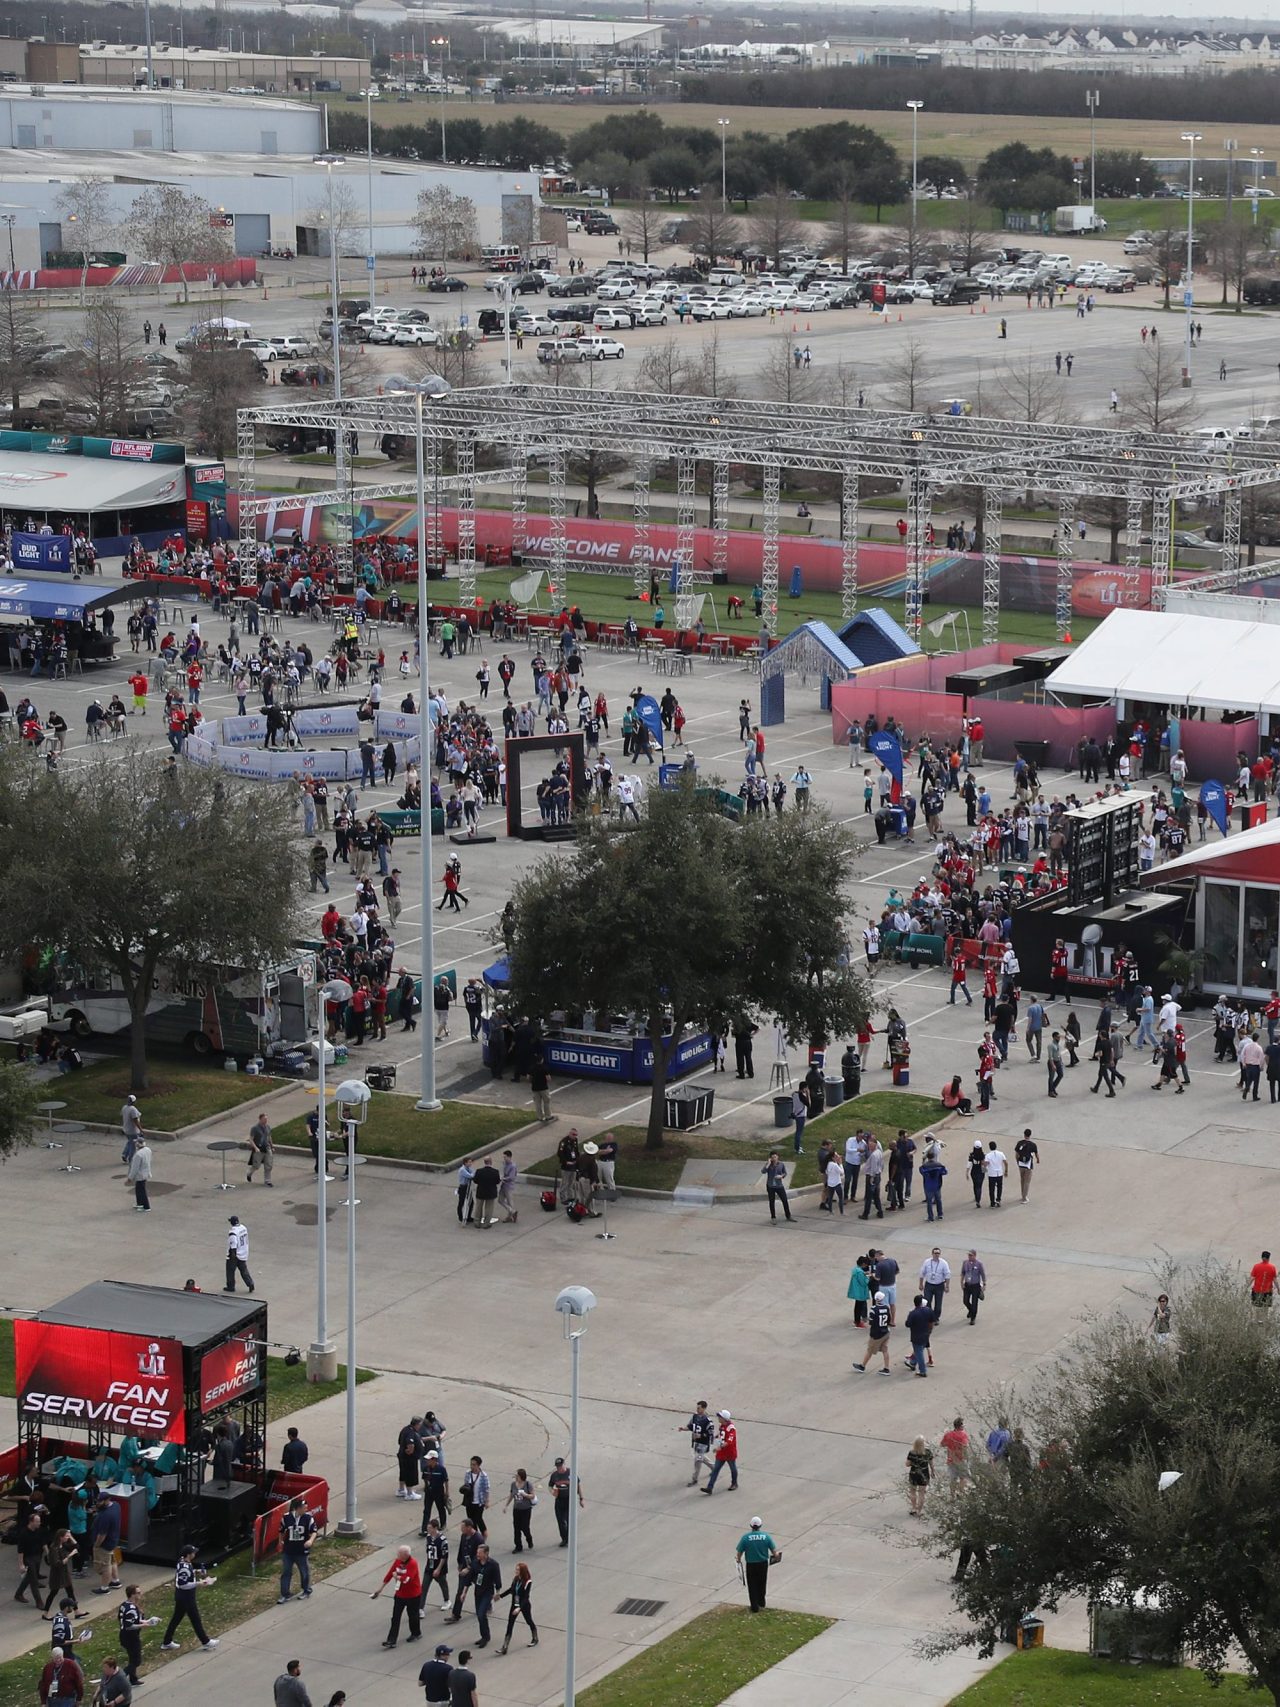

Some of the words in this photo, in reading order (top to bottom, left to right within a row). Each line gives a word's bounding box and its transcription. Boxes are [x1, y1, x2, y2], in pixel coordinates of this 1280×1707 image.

[136, 444, 152, 452] SHOP
[18, 550, 40, 559] LIGHT
[354, 616, 363, 624] 12
[630, 624, 637, 632] 12
[60, 650, 68, 658] 12
[251, 663, 260, 672] 56
[592, 724, 598, 732] 12
[230, 734, 266, 742] NETWO
[584, 772, 590, 780] 12
[1020, 823, 1026, 831] 12
[1172, 835, 1182, 844] 87
[1065, 942, 1114, 978] LI
[1130, 970, 1139, 982] 21
[466, 993, 476, 1004] 12
[552, 1050, 576, 1062] BUD
[577, 1053, 618, 1068] LIGHT
[681, 1049, 692, 1061] BUD
[879, 1314, 888, 1326] 12
[137, 1352, 166, 1375] LI
[234, 1352, 258, 1374] FAN
[204, 1368, 258, 1403] SERVICES
[107, 1381, 169, 1407] FAN
[23, 1392, 170, 1430] SERVICES
[288, 1526, 305, 1541] 12
[428, 1544, 438, 1560] 21
